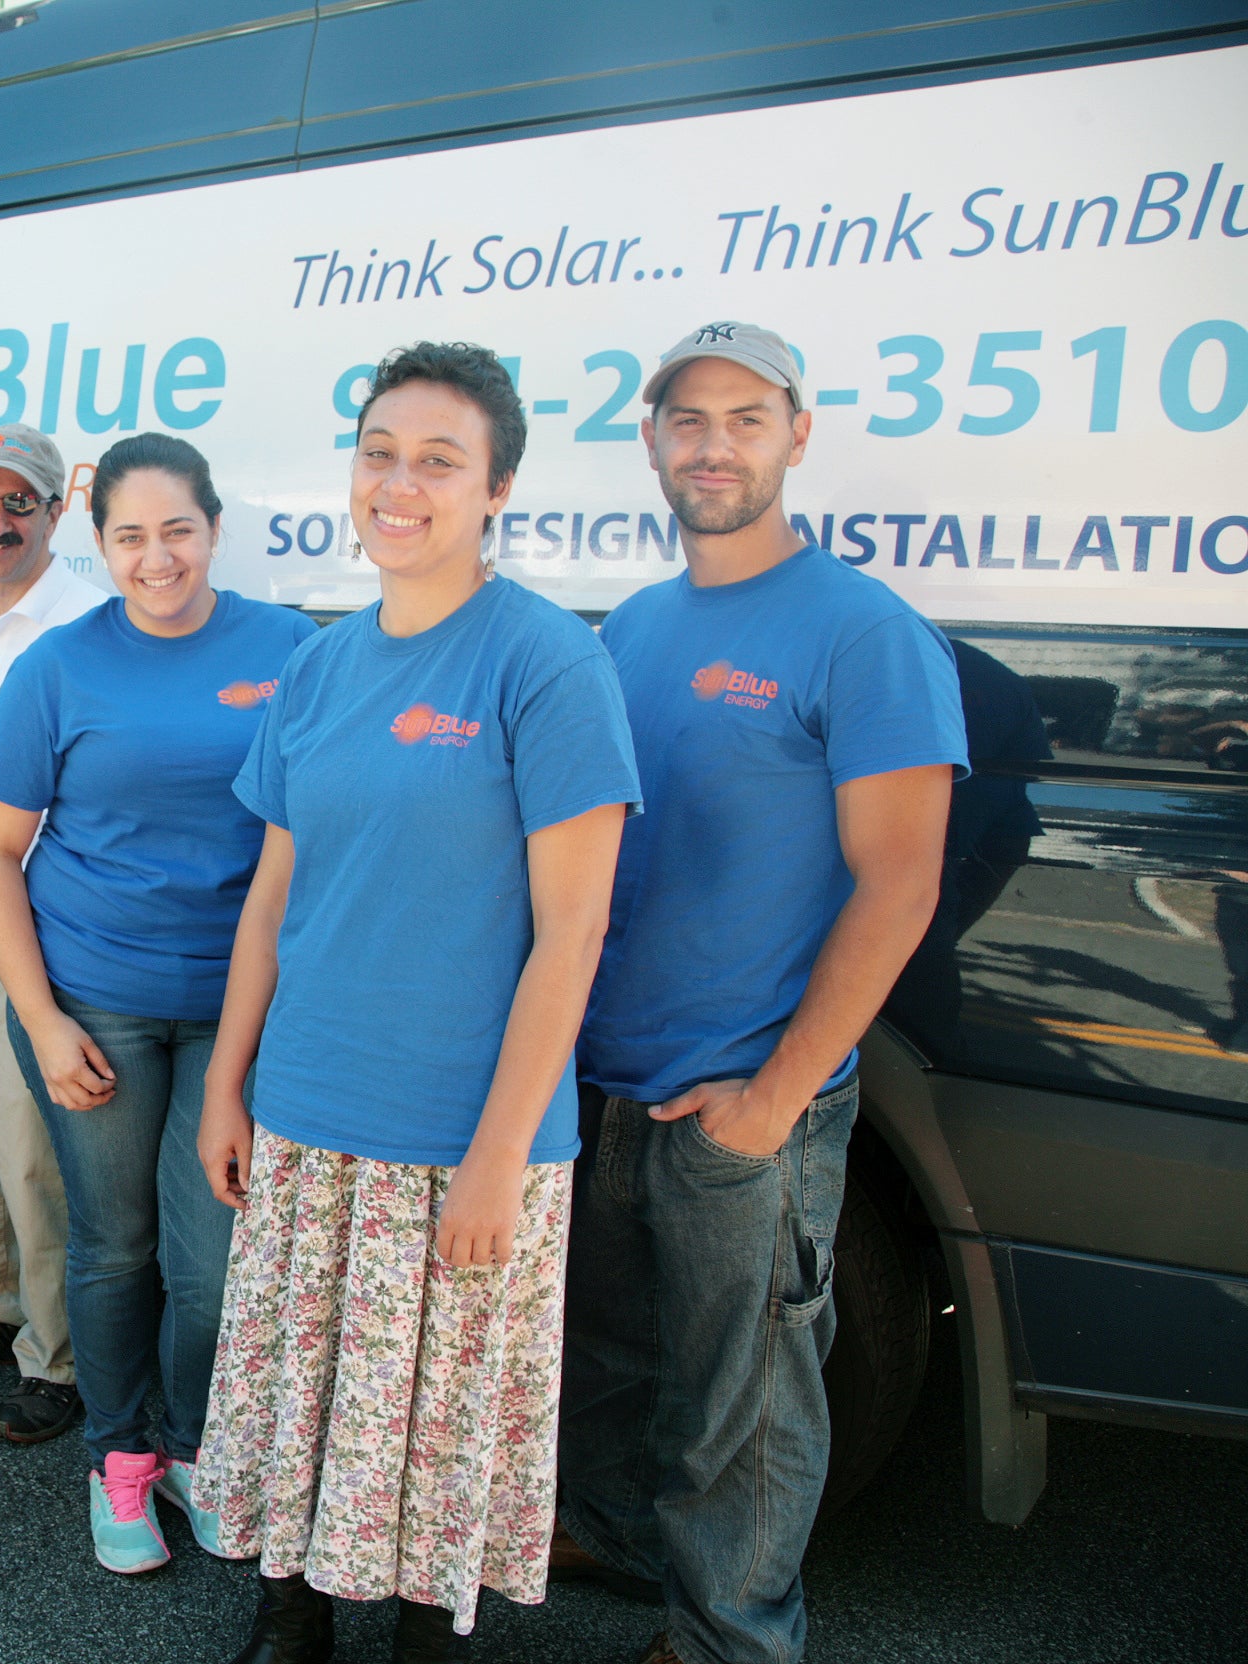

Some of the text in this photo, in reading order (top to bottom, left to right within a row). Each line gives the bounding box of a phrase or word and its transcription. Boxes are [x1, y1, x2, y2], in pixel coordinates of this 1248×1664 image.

[293, 239, 452, 309] Think
[463, 225, 684, 295] Solar...
[717, 192, 934, 274] Think
[483, 511, 677, 562] ESIGN
[788, 512, 1248, 575] NSTALLATIO
[690, 668, 779, 699] SunBlue
[724, 693, 770, 710] ENERGY
[390, 713, 481, 738] SunBlue
